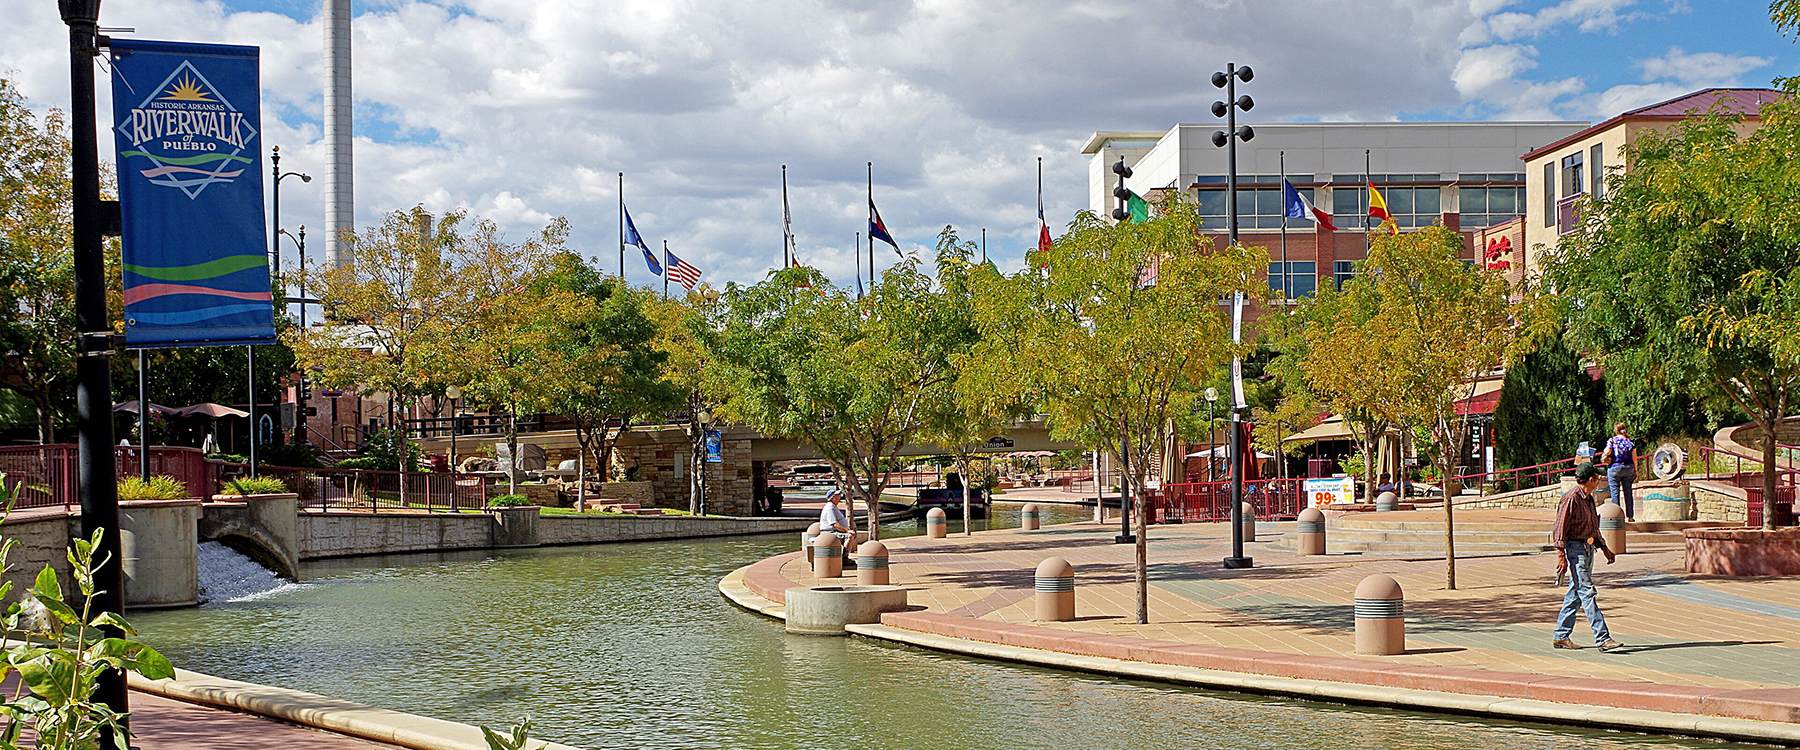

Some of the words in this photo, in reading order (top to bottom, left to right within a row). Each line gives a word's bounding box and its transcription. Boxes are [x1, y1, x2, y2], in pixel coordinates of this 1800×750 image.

[151, 102, 187, 110] HISTORIC
[187, 102, 225, 111] ARKANSAS
[131, 108, 245, 150] RIVERWALK
[182, 132, 194, 143] of
[163, 141, 217, 151] PUEBLO
